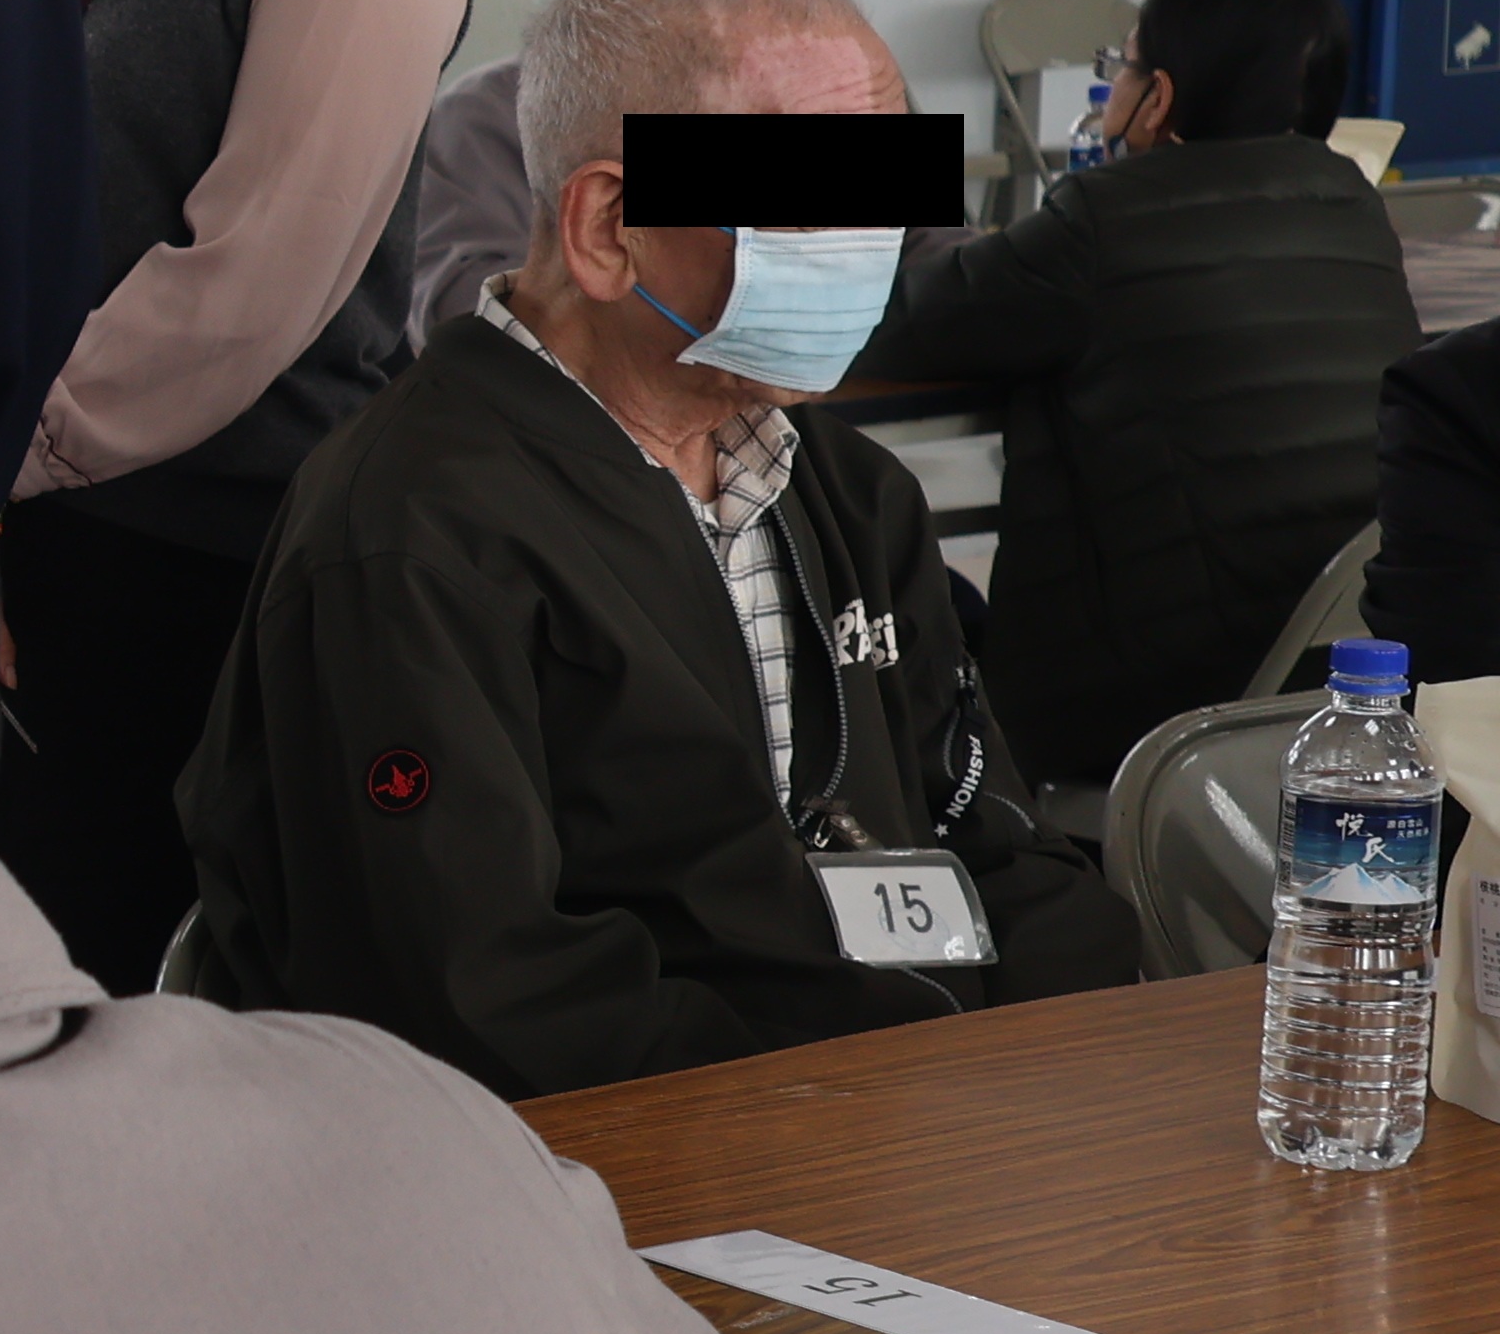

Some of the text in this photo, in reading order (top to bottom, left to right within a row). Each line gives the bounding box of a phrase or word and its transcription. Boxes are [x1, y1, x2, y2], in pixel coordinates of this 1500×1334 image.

[946, 733, 984, 819] FASHION
[1336, 811, 1395, 863] 悅氏
[874, 882, 934, 933] 15
[802, 1276, 922, 1307] 15
